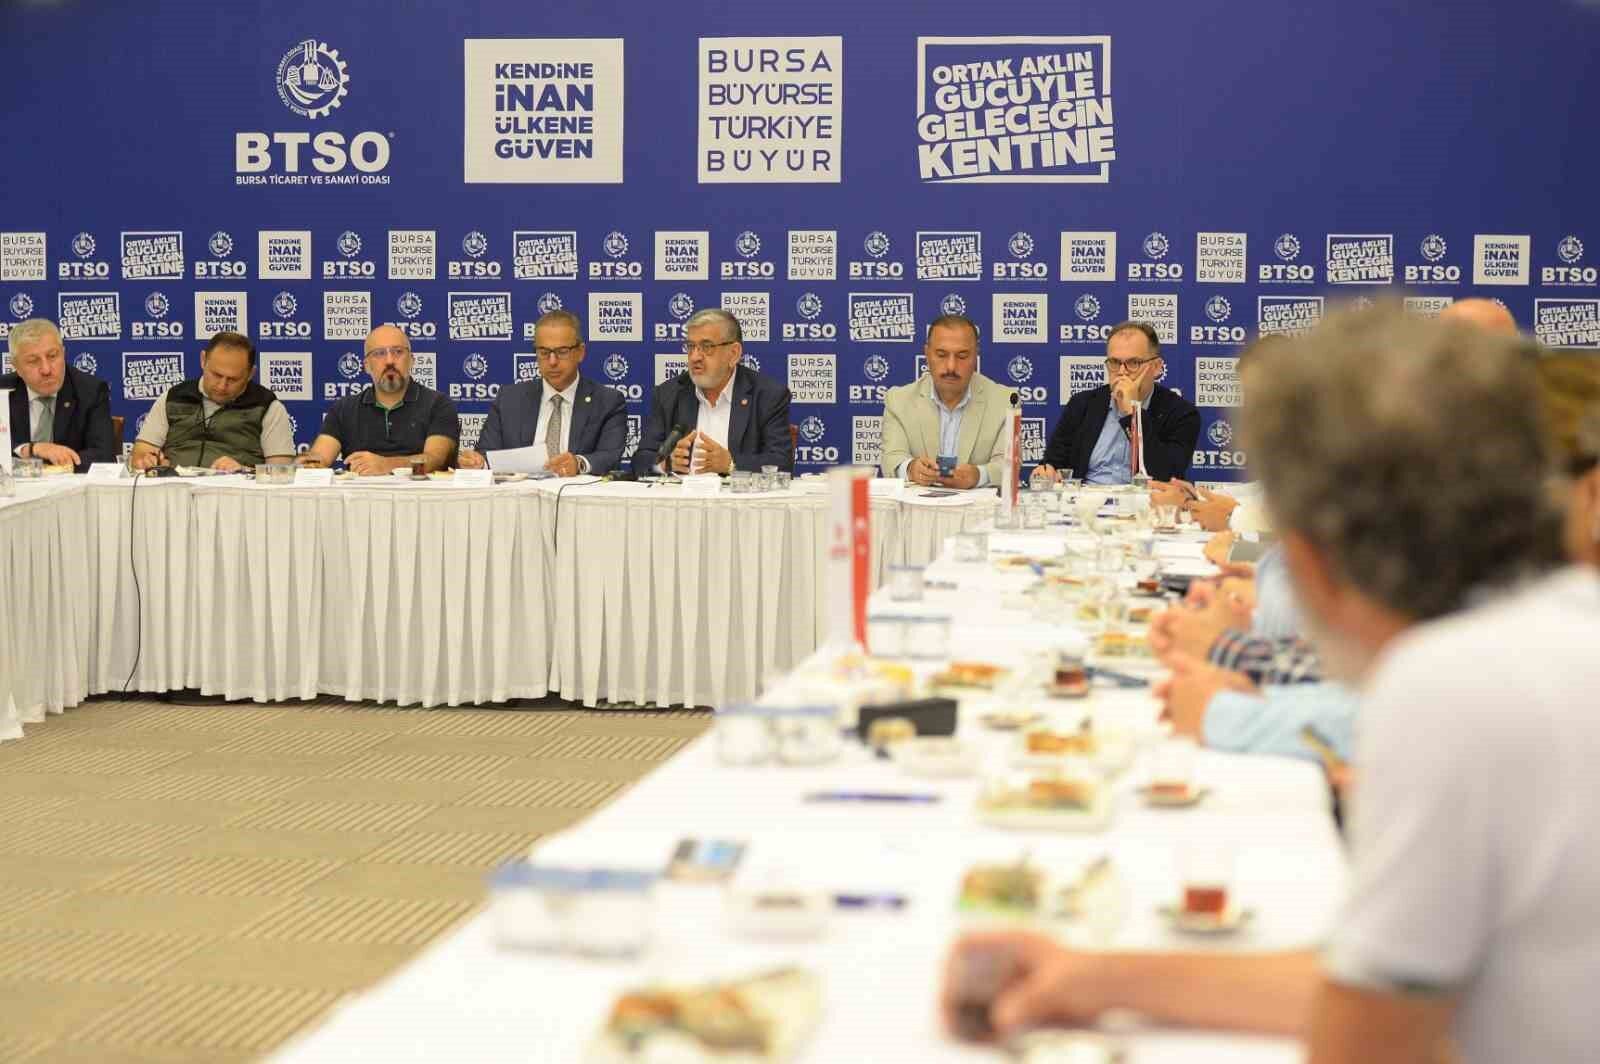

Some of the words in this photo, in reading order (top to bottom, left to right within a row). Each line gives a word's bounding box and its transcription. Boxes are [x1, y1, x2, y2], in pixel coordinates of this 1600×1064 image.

[707, 48, 833, 73] BURSA
[932, 59, 1014, 86] ORTAK
[1020, 51, 1093, 79] AKLIN
[708, 83, 833, 105] BÜYÜRSE
[495, 116, 593, 134] ÜLKENE
[236, 132, 390, 173] BTSO
[494, 138, 593, 159] GÜVEN
[707, 149, 831, 171] BÜYÜR
[236, 176, 267, 184] BURSA
[310, 176, 323, 184] VE
[361, 176, 388, 184] ODASI
[126, 239, 152, 248] ORTAK
[391, 235, 433, 243] BURSA
[518, 239, 545, 248] ORTAK
[791, 235, 834, 243] BURSA
[921, 239, 948, 248] ORTAK
[1200, 237, 1243, 245] BURSA
[1332, 242, 1359, 251] ORTAK
[59, 262, 109, 276] BTSO
[194, 261, 246, 276] BTSO
[323, 262, 375, 276] BTSO
[448, 262, 501, 276] BTSO
[589, 262, 642, 276] BTSO
[721, 262, 774, 276] BTSO
[850, 262, 903, 277] BTSO
[993, 262, 1048, 277] BTSO
[1128, 264, 1183, 278] BTSO
[1260, 265, 1314, 280] BTSO
[1405, 266, 1460, 281] BTSO
[1541, 268, 1597, 282] BTSO
[64, 300, 89, 309] ORTAK
[327, 296, 368, 304] BURSA
[453, 300, 479, 309] ORTAK
[724, 297, 766, 305] BURSA
[854, 300, 881, 310] ORTAK
[1131, 299, 1174, 307] BURSA
[1263, 304, 1291, 313] ORTAK
[1541, 307, 1568, 316] ORTAK
[131, 323, 184, 337] BTSO
[260, 322, 311, 337] BTSO
[782, 324, 837, 338] BTSO
[1191, 326, 1246, 342] BTSO
[127, 360, 153, 369] ORTAK
[791, 358, 834, 366] BURSA
[1192, 450, 1246, 466] BTSO
